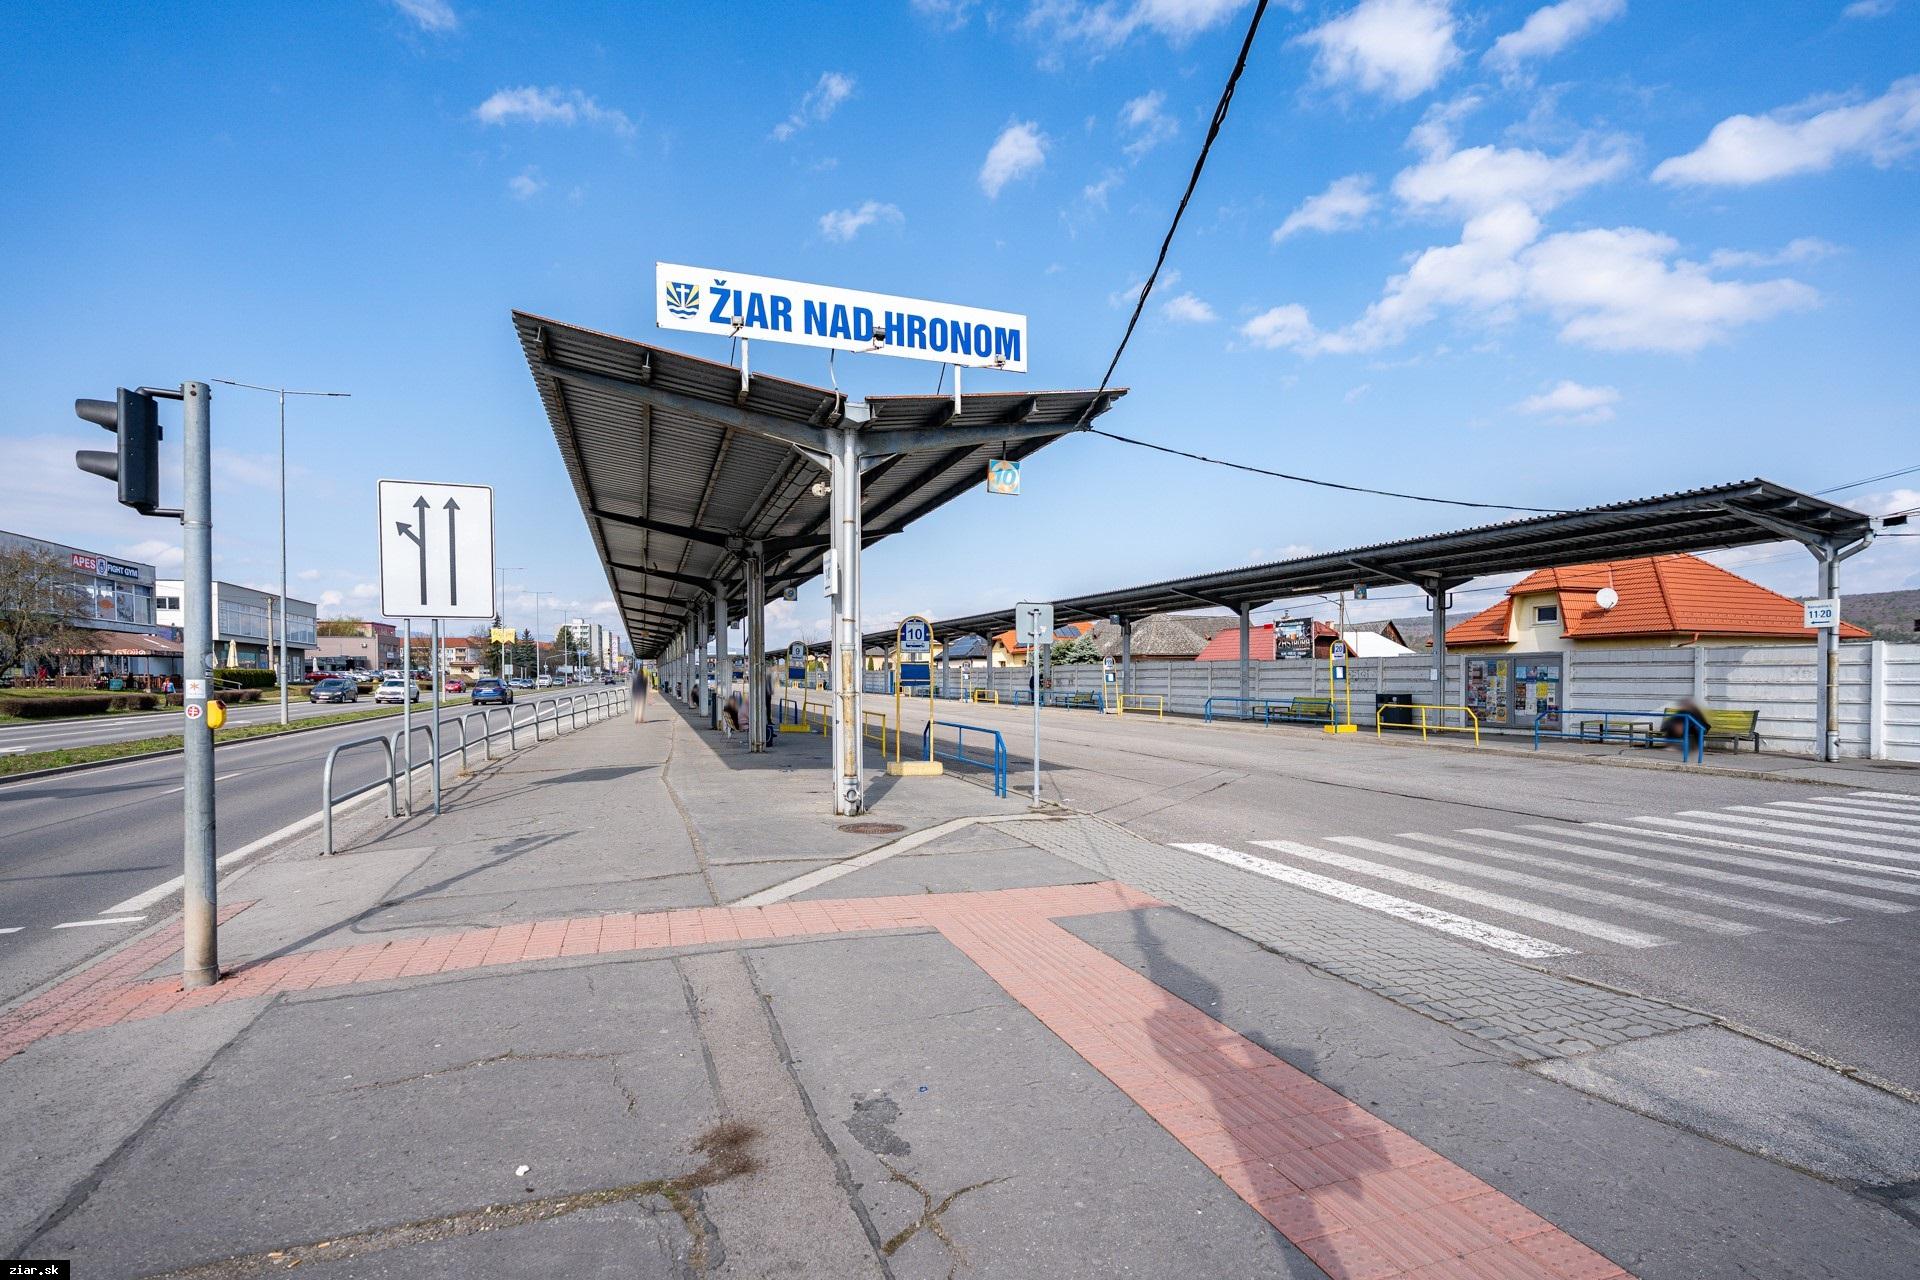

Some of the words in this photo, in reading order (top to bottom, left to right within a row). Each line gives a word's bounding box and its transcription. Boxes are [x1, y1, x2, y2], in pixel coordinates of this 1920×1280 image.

[709, 278, 793, 332] ŽIAR
[804, 299, 874, 342] NAD
[884, 310, 1021, 362] HRONOM
[993, 468, 1017, 485] 10
[72, 555, 96, 570] APES
[107, 563, 124, 575] FIGHT
[124, 568, 138, 578] GYM
[907, 628, 923, 640] 10
[1335, 645, 1343, 653] 20
